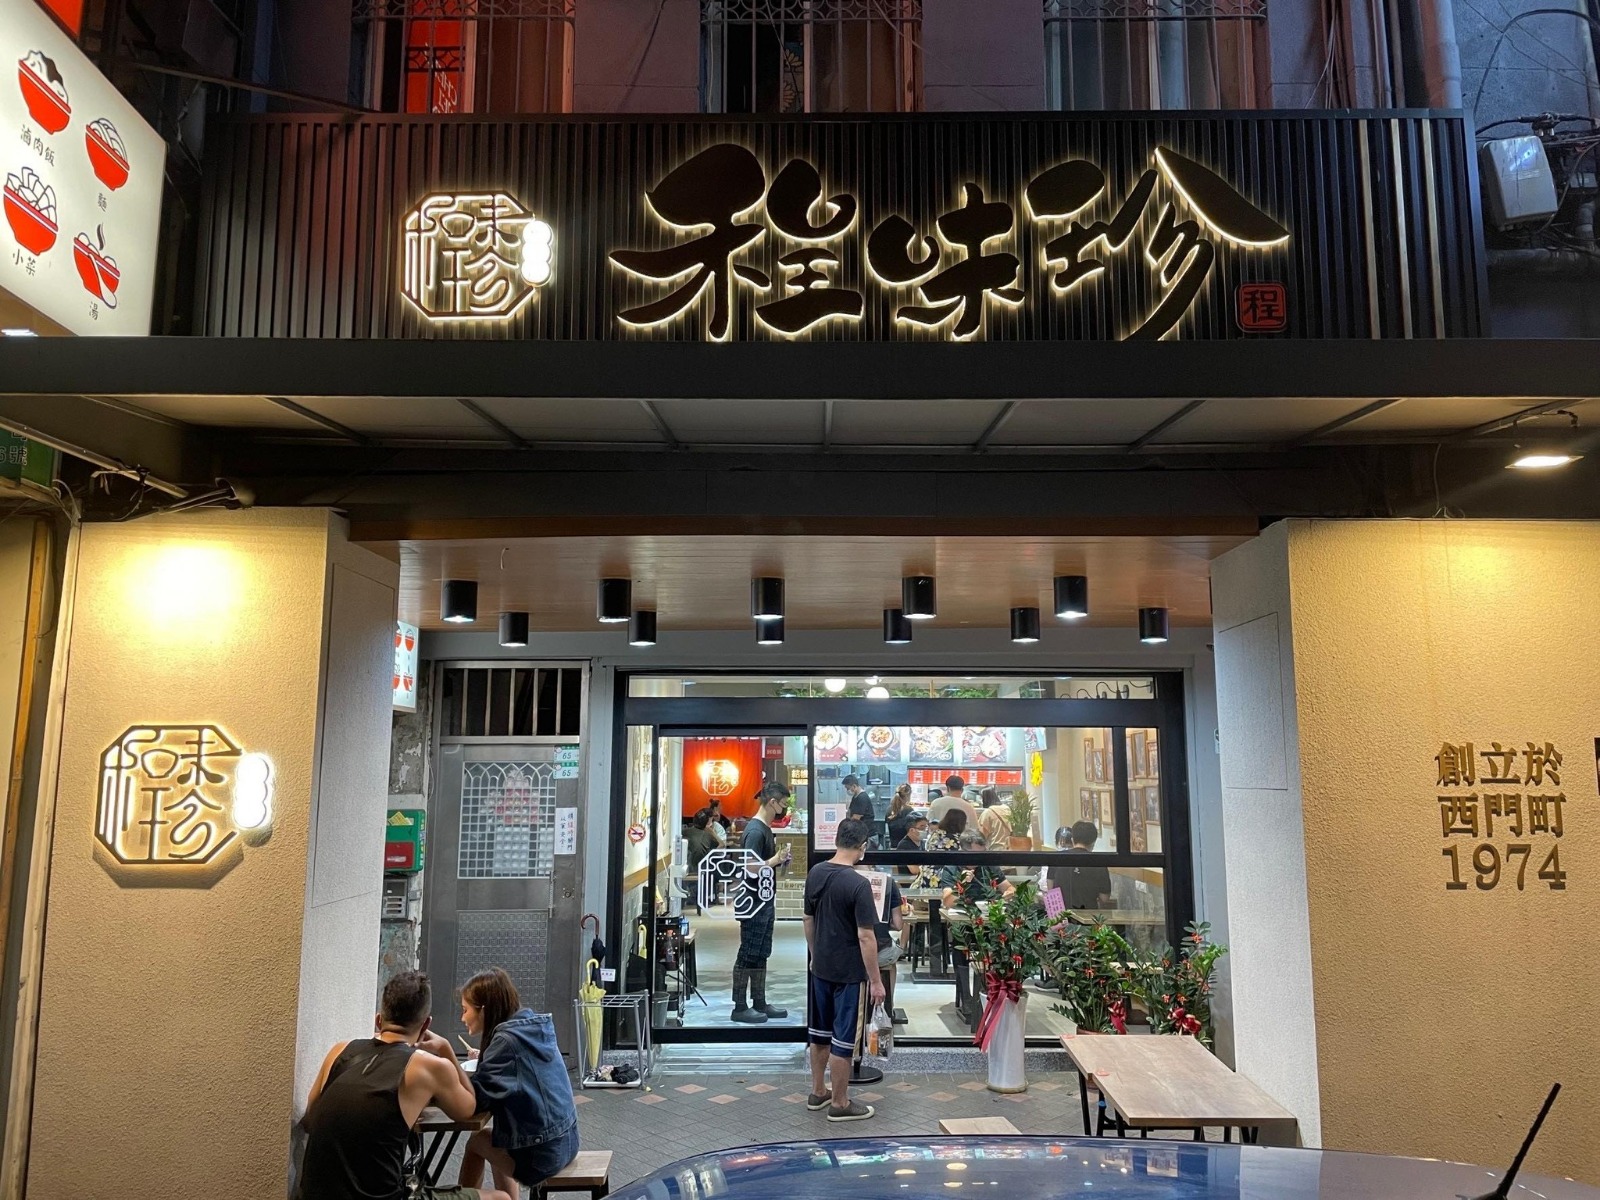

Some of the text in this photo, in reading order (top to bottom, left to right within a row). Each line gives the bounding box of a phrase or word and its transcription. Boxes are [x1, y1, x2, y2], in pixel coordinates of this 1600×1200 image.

[20, 124, 55, 167] 滷肉飯
[12, 248, 36, 277] 小菜
[608, 143, 1290, 341] 程味珍
[88, 300, 99, 320] 湯
[1242, 289, 1285, 324] 程
[1434, 741, 1563, 787] 創立於
[1437, 792, 1567, 838] 西門町
[1442, 843, 1567, 891] 1974
